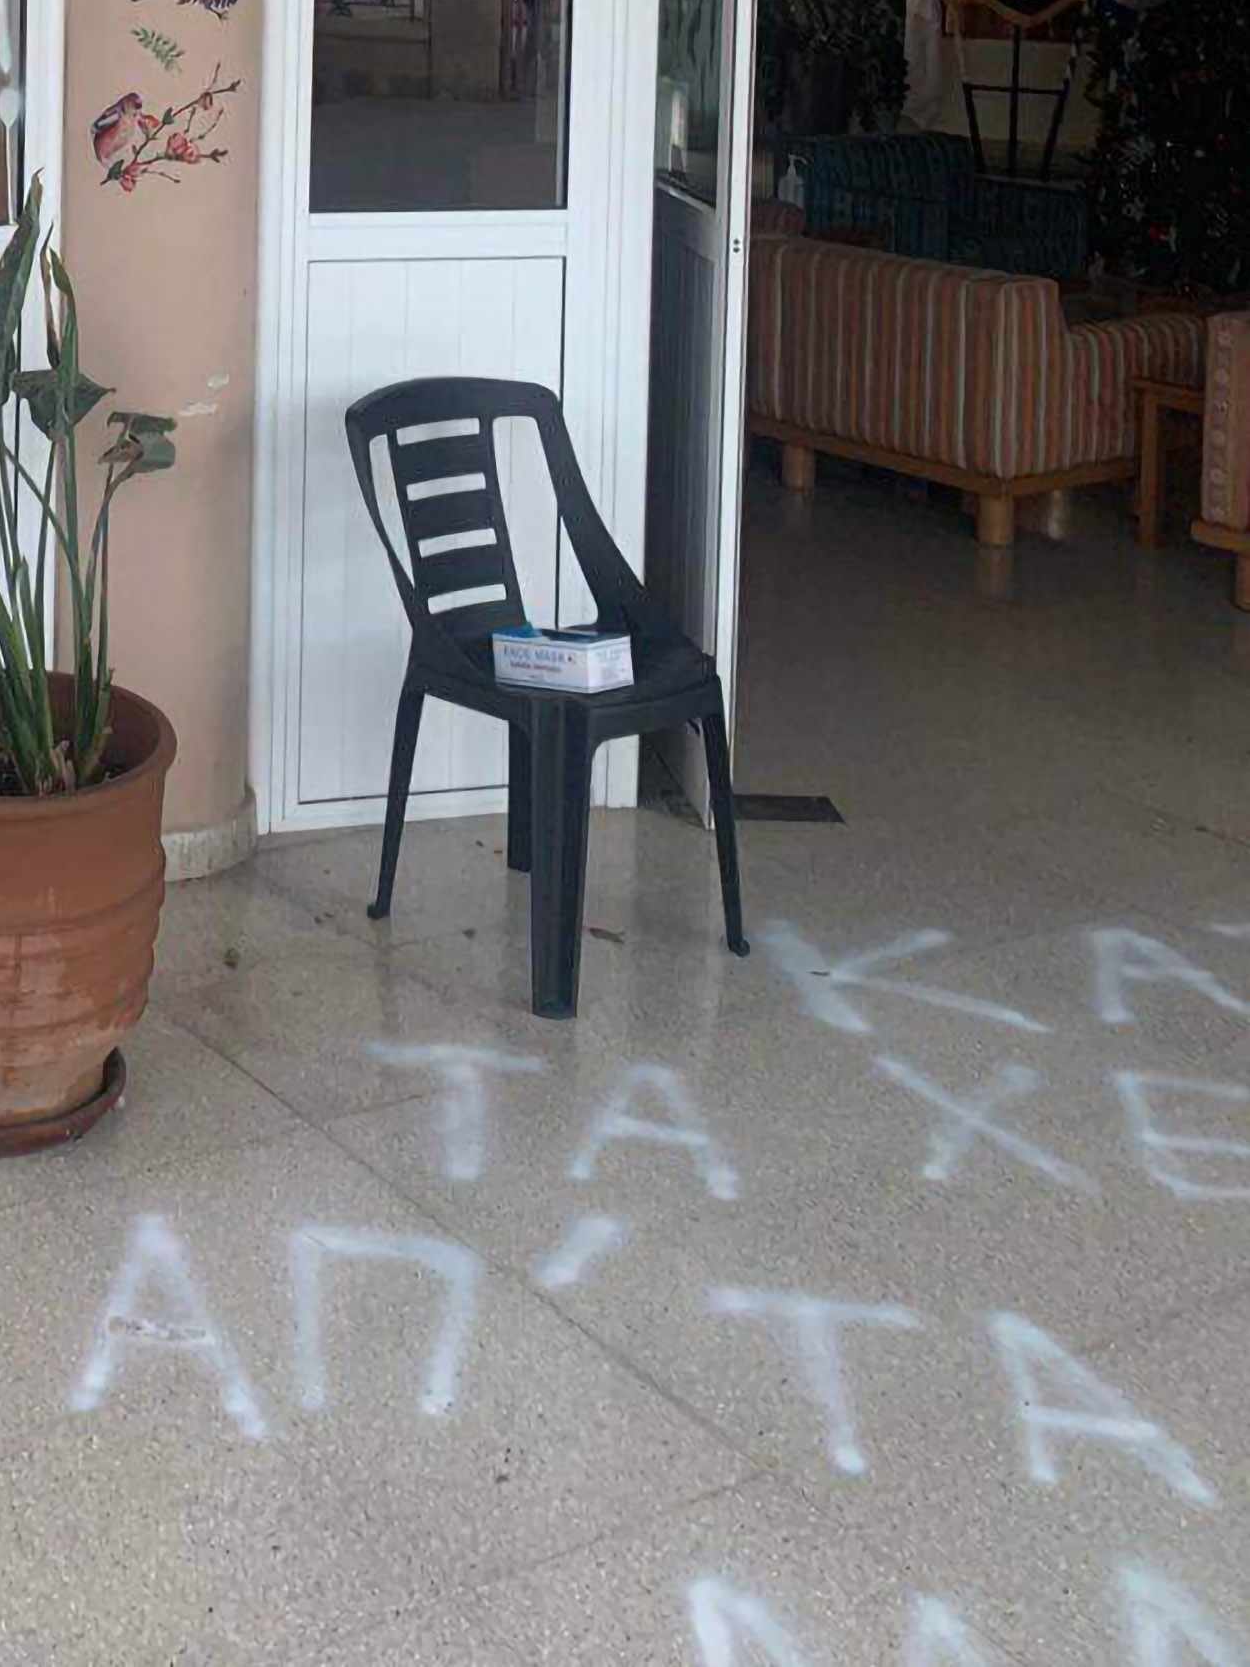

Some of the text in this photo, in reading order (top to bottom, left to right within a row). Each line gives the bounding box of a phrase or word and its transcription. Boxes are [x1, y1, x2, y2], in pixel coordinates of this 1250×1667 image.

[753, 919, 1250, 1034] ΚΑ
[362, 1038, 740, 1202] ΤΑ
[706, 1284, 1218, 1508] ΤΑ
